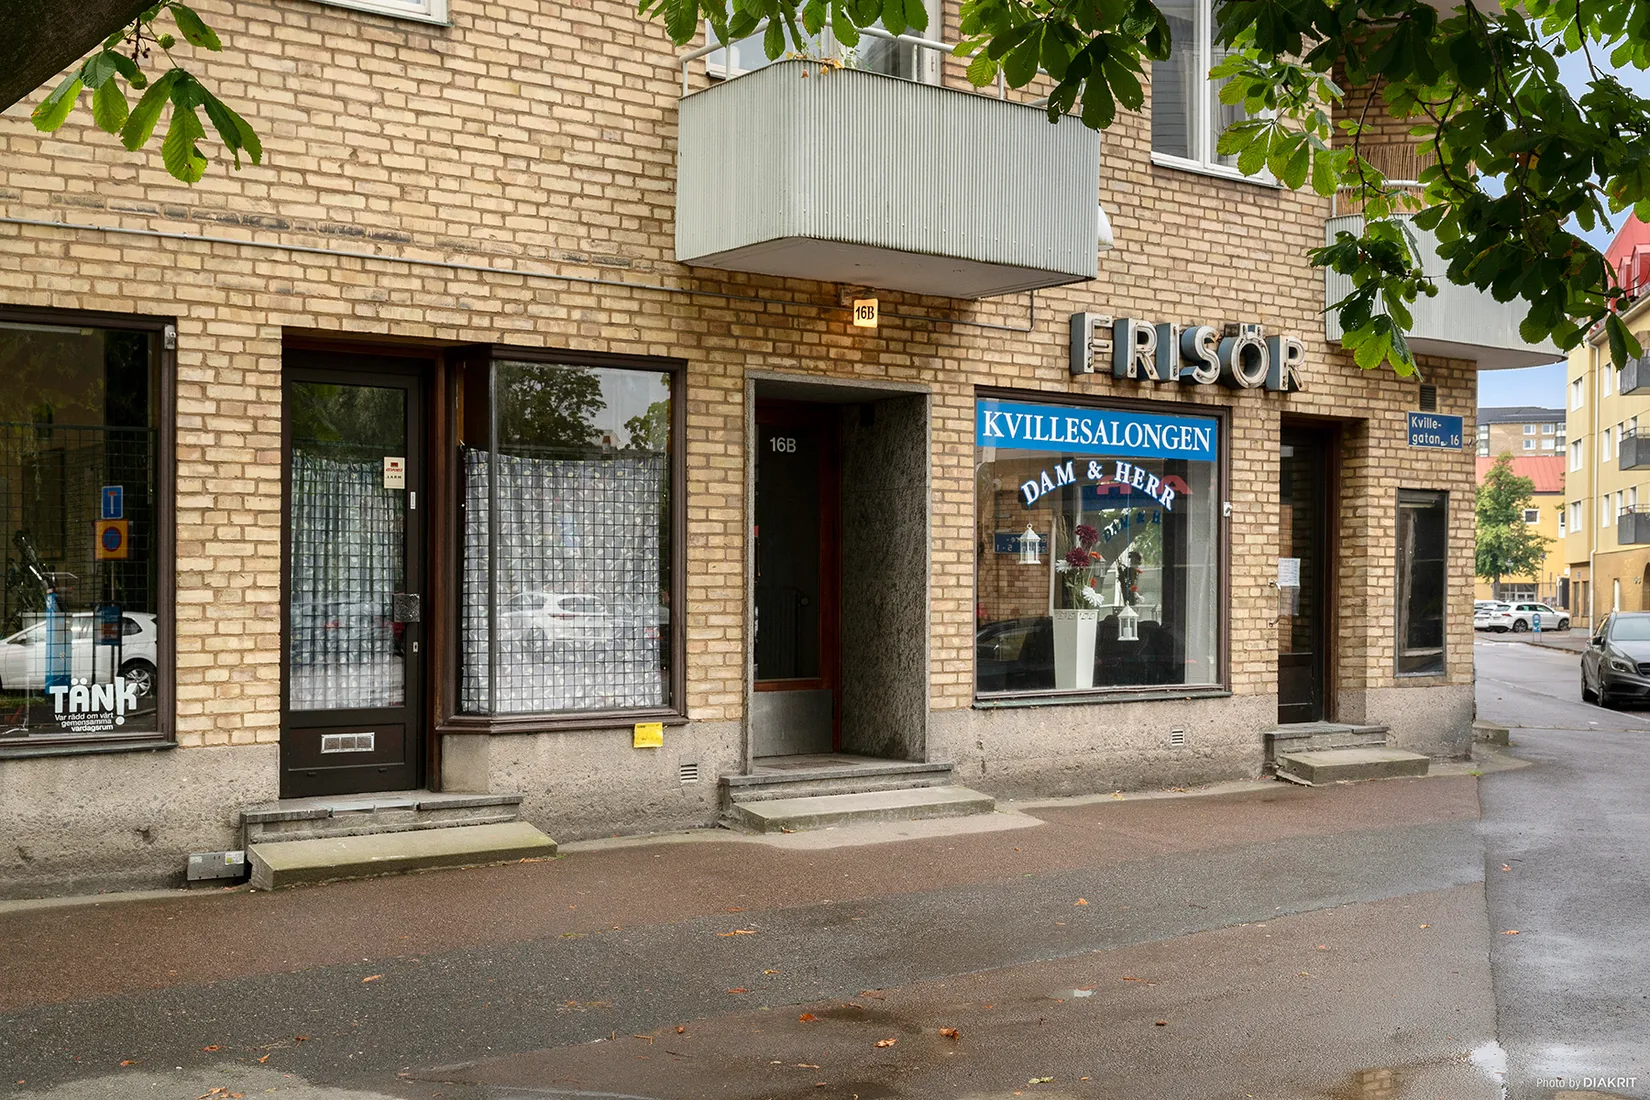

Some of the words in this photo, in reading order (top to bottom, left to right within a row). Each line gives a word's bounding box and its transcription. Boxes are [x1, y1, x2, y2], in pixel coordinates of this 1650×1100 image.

[855, 305, 875, 321] 16B
[1070, 311, 1306, 392] FRISÖR
[1411, 416, 1442, 429] Kville-
[982, 410, 1212, 453] KVILLESALONGEN
[1411, 432, 1441, 446] gatan
[1450, 434, 1460, 446] 16
[769, 437, 797, 453] 16B
[1020, 460, 1077, 506] DAM
[1086, 460, 1104, 481] &
[1114, 460, 1176, 512] HERR
[61, 719, 112, 728] gemensamma
[71, 724, 113, 732] vardagsrum
